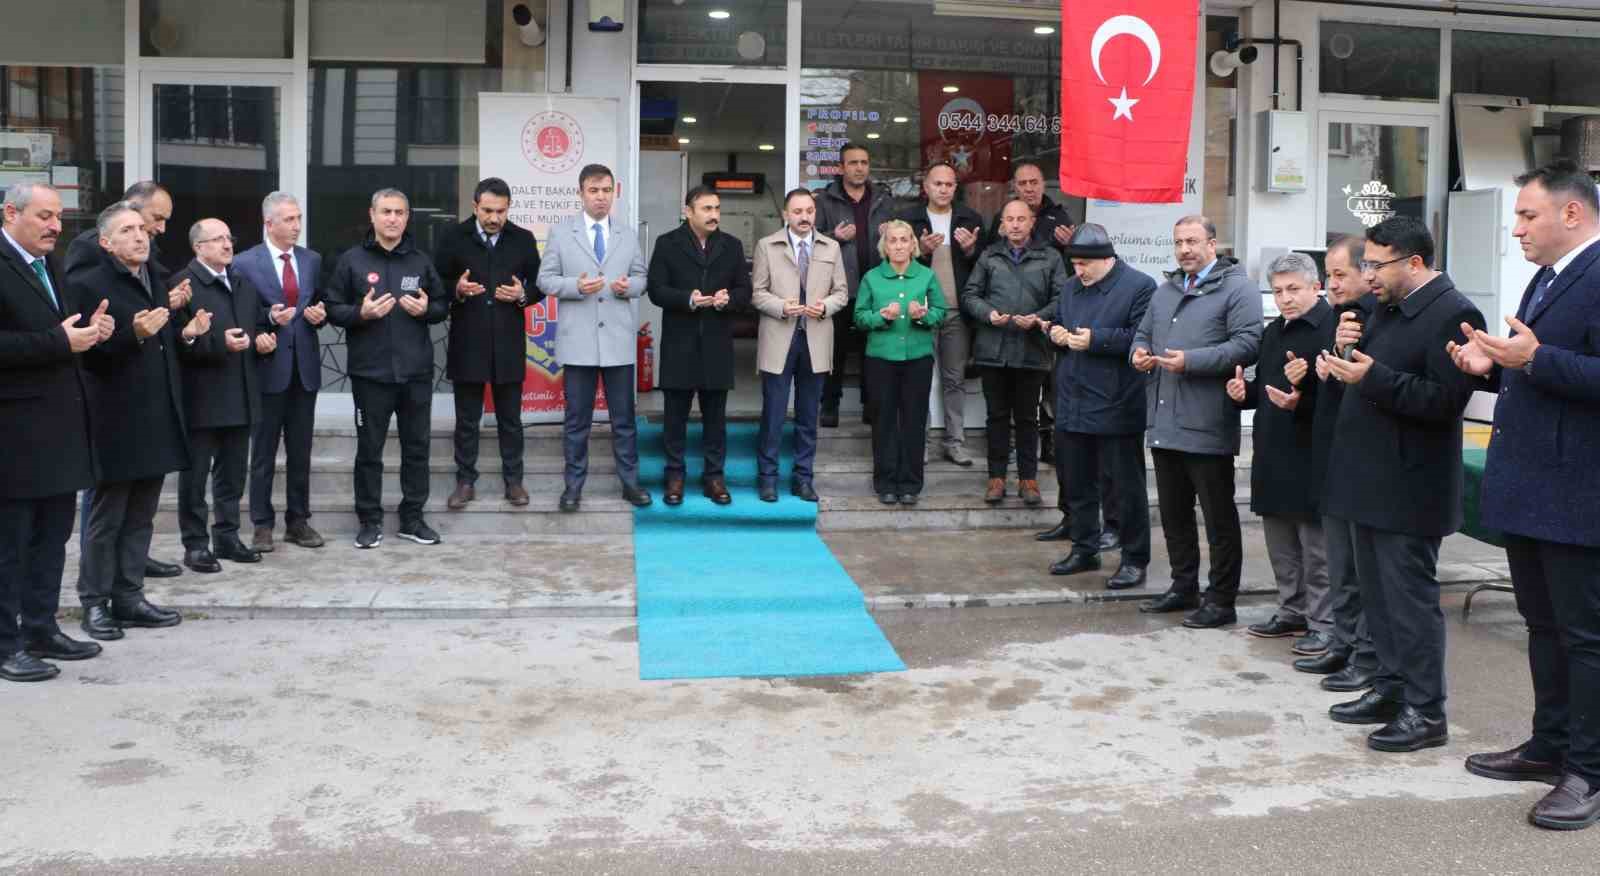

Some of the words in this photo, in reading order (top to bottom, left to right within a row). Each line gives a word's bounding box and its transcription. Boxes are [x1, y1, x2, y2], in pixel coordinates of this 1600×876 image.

[938, 113, 983, 131] 0544
[987, 114, 1021, 132] 344
[1024, 115, 1047, 133] 64
[1051, 117, 1062, 134] 5
[511, 186, 543, 196] DALET
[545, 187, 577, 196] BAKAN
[509, 200, 523, 209] ZA
[524, 201, 537, 209] VE
[509, 215, 536, 225] ENEL
[1109, 232, 1152, 247] opluma
